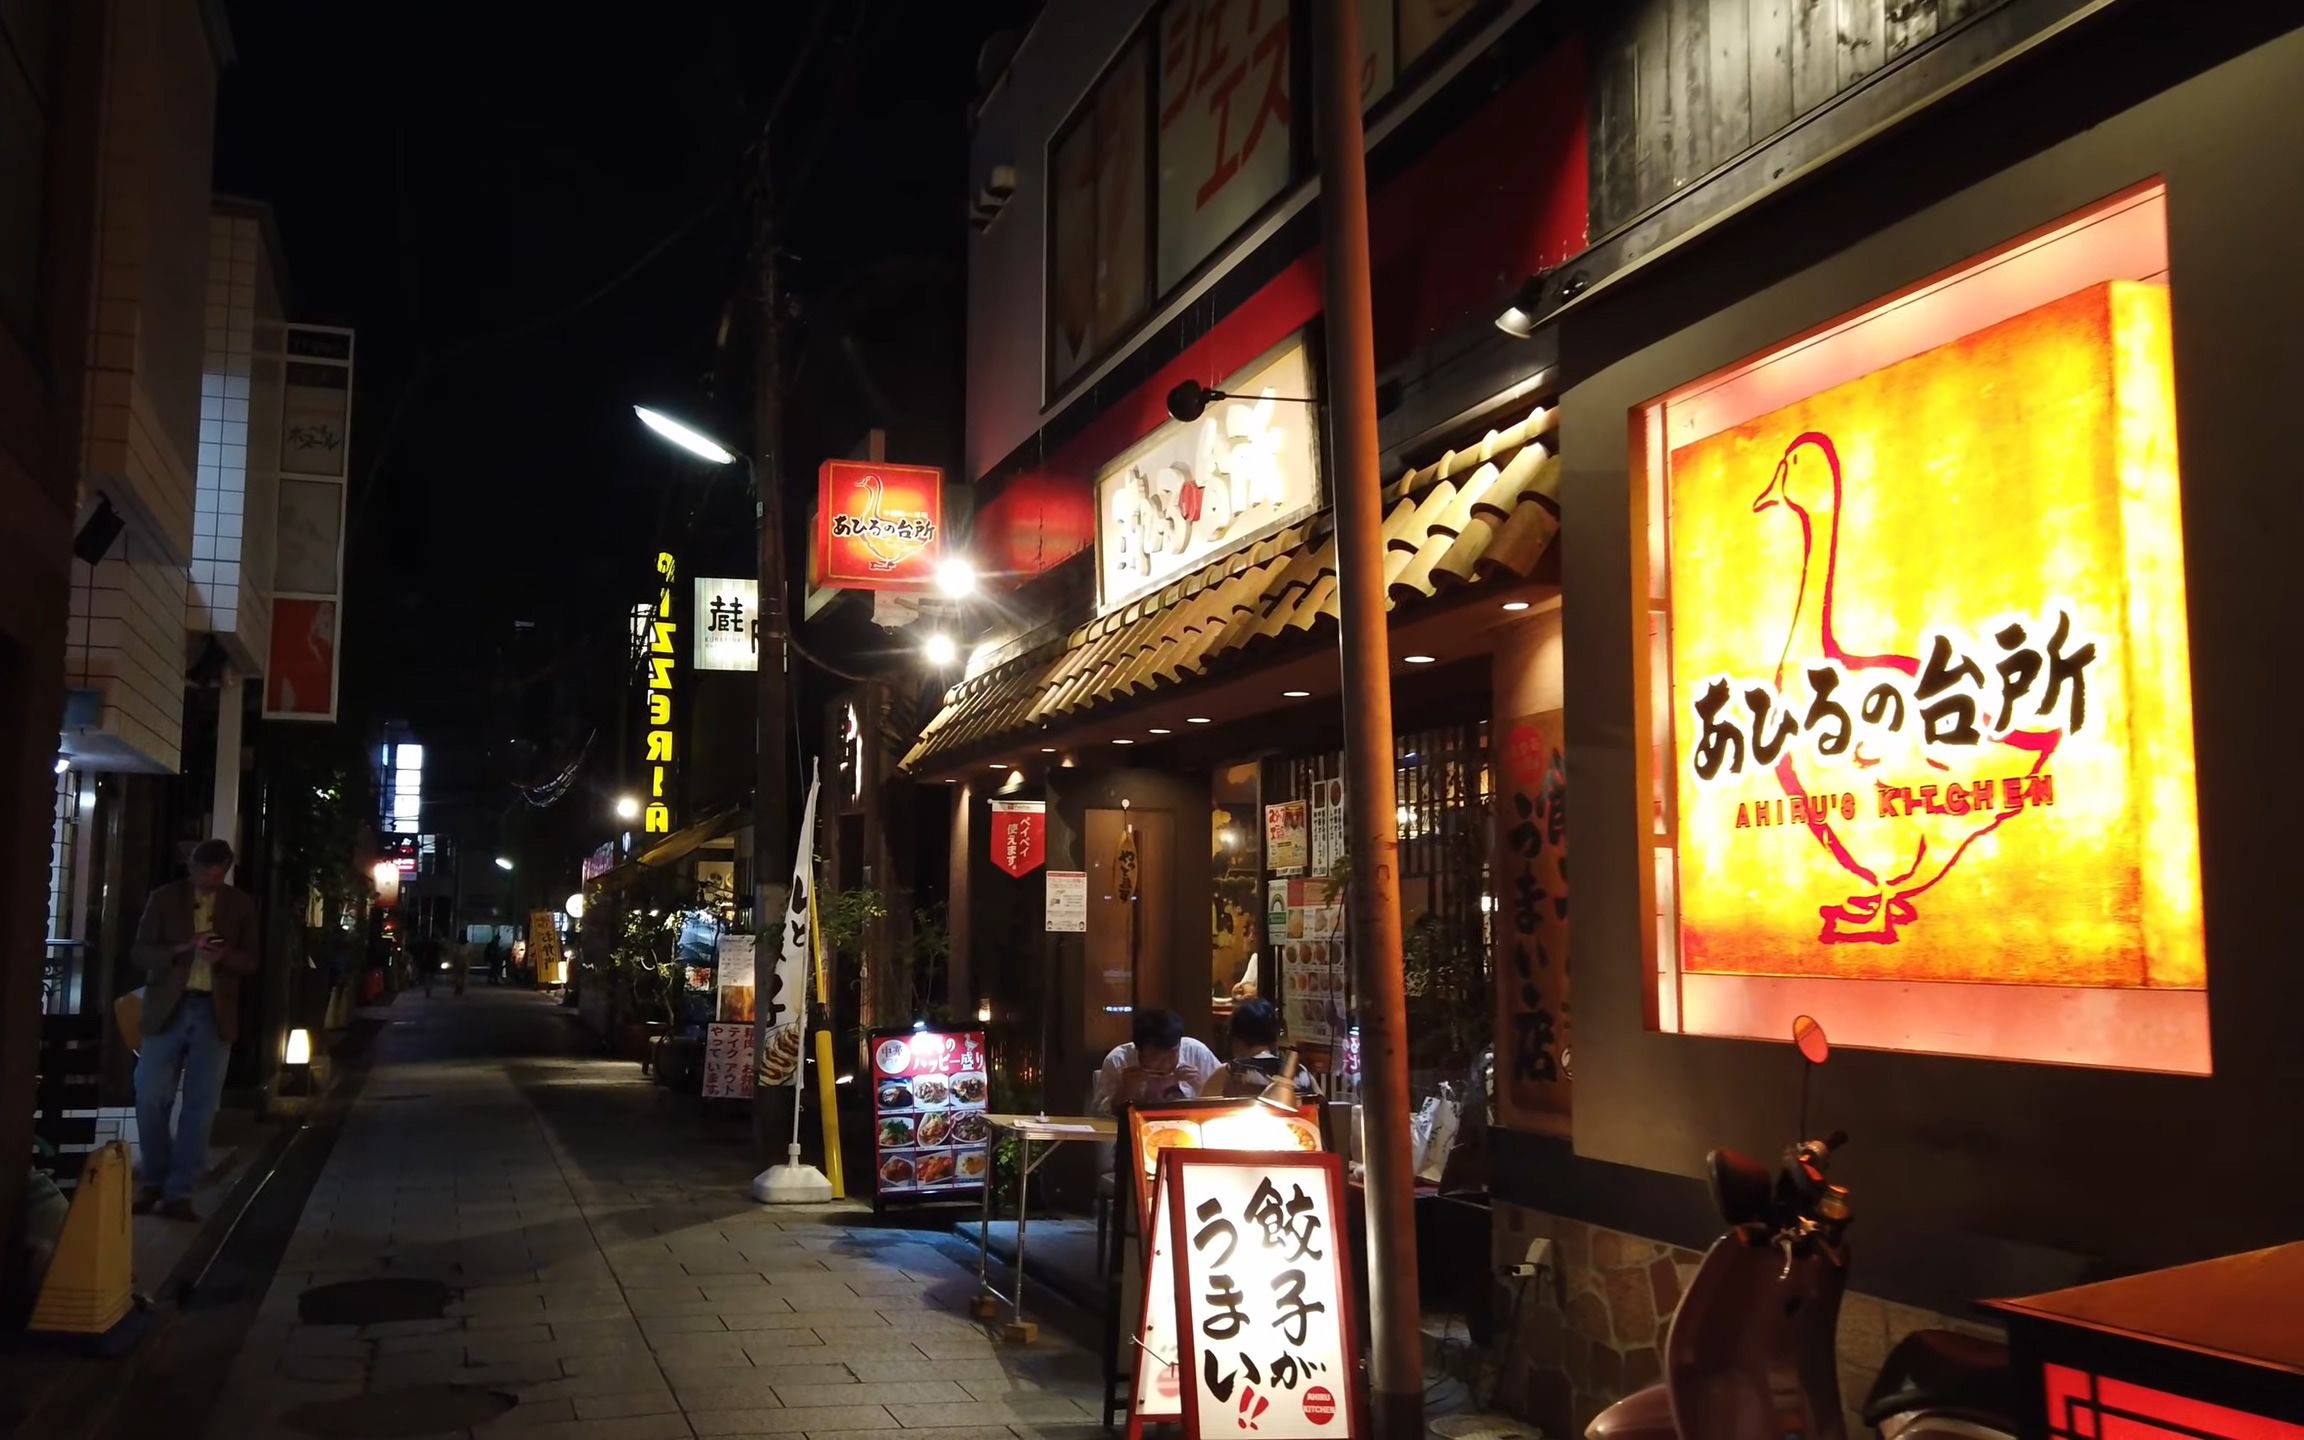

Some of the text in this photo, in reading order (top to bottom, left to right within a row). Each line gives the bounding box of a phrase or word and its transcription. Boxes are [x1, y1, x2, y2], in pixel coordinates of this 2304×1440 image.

[833, 515, 935, 541] あひるの台所
[1694, 609, 2097, 781] あひるの台所
[1736, 773, 2054, 829] AHIRU'S KITCHEN
[1006, 823, 1019, 870] 使えます。
[1019, 816, 1031, 857] ペイペイ
[724, 1027, 741, 1095] テイクアウト
[912, 1051, 984, 1073] ハッピー盛り
[1243, 1175, 1327, 1390] 餃子が
